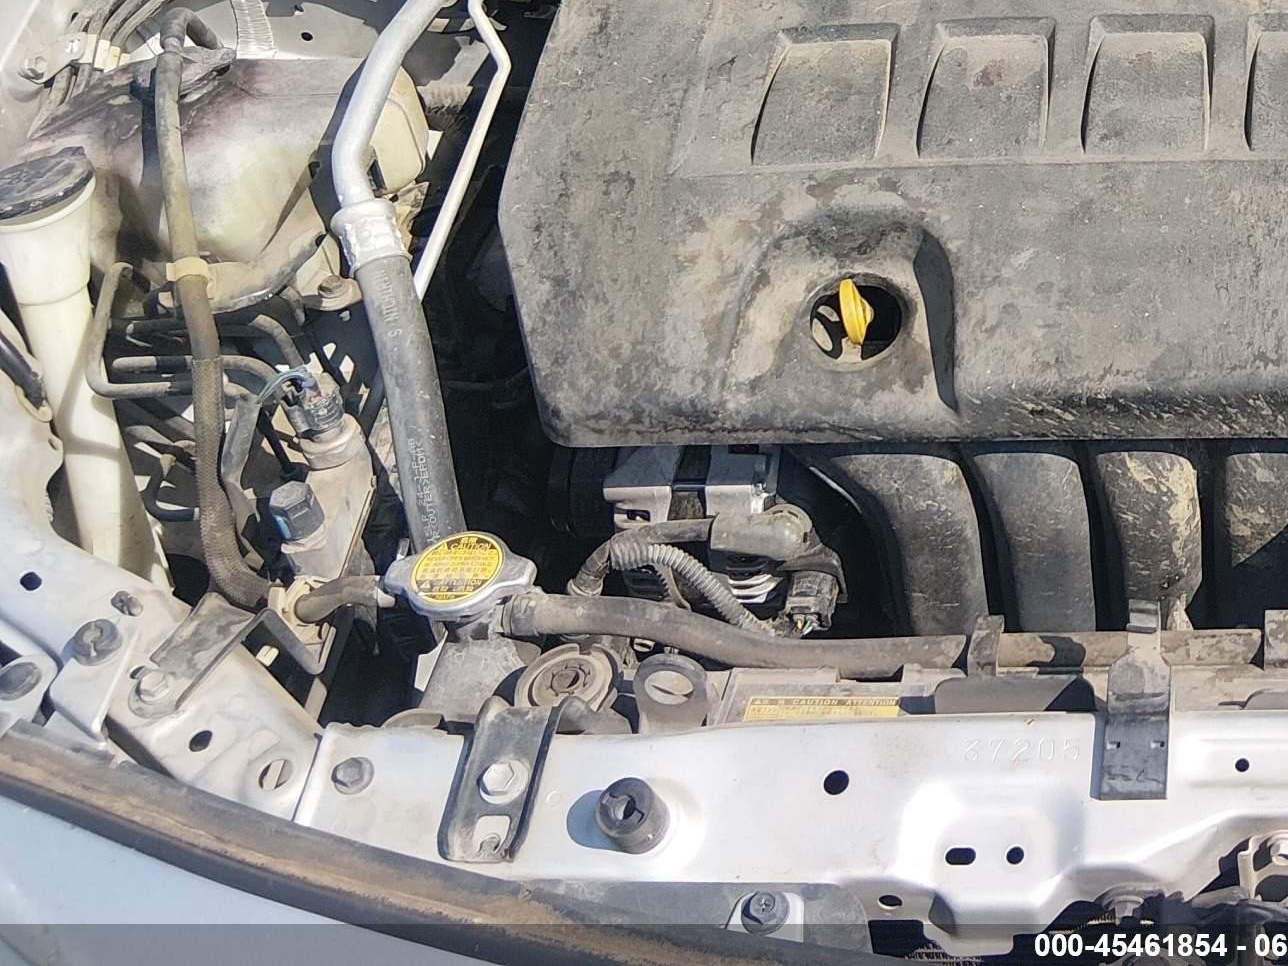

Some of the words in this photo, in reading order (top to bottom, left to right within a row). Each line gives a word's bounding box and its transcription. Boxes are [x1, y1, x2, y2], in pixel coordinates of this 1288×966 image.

[450, 542, 491, 550] CAUTION
[792, 698, 838, 706] CAUTION
[846, 698, 897, 706] ATTENTION
